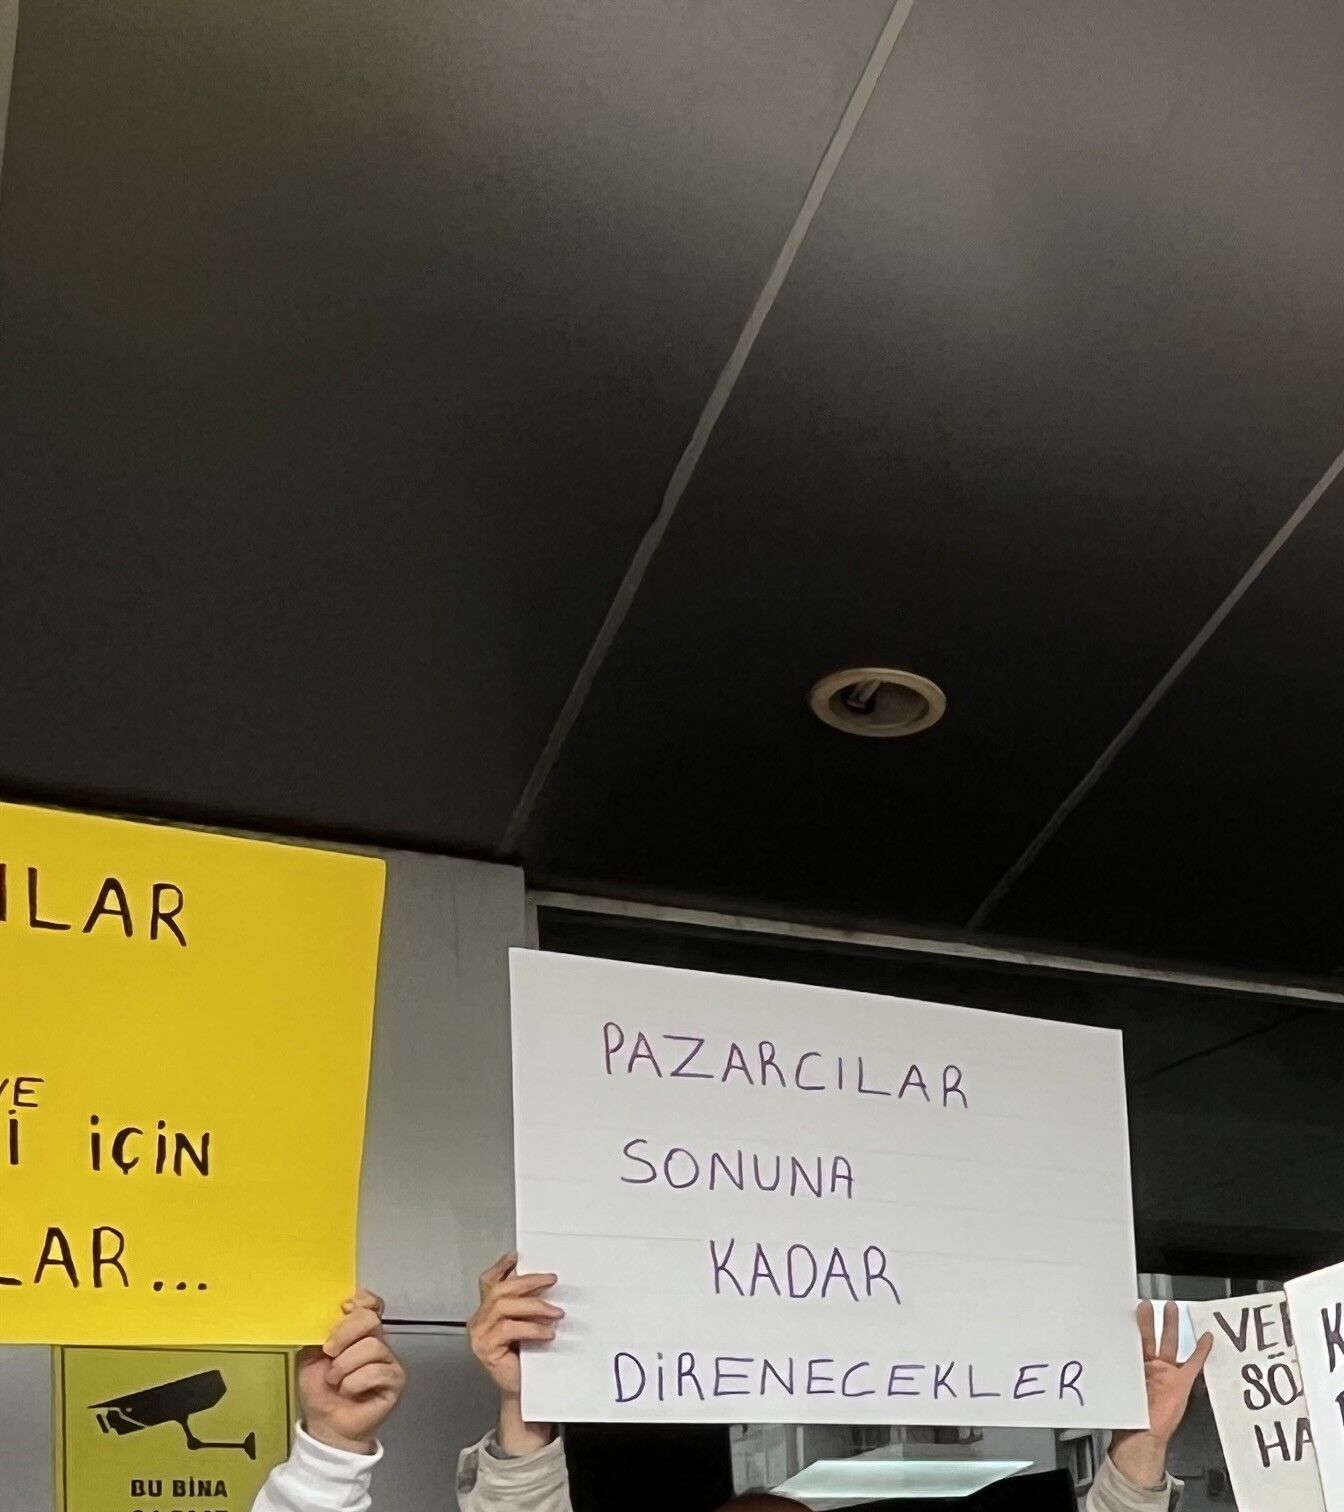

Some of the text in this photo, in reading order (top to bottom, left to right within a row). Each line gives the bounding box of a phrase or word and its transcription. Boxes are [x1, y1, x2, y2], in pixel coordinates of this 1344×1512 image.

[602, 1022, 969, 1108] PAZARCILAR
[620, 1139, 854, 1199] SONUNA
[709, 1238, 901, 1305] KADAR
[613, 1352, 1085, 1406] DİRENECEKLER
[131, 1476, 228, 1497] BU BİNA
